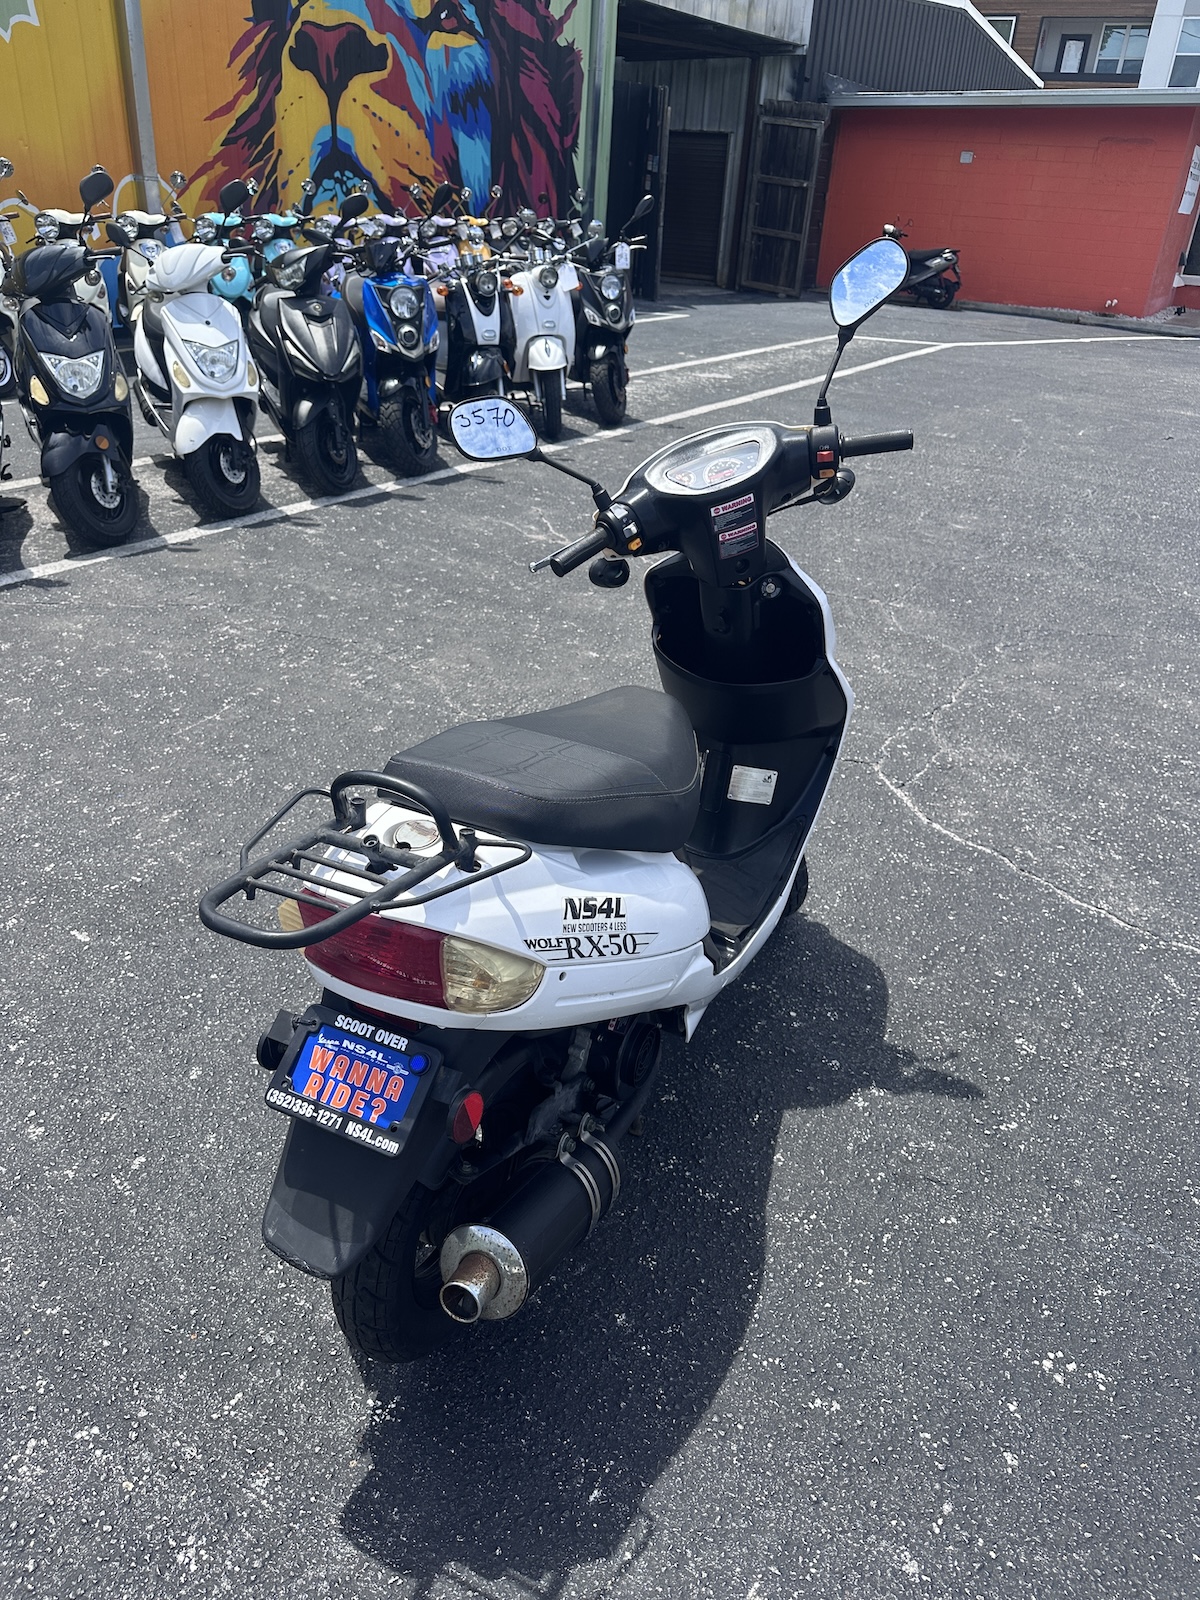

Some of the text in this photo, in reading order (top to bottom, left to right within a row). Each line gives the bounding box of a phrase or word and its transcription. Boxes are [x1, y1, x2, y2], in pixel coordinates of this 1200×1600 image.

[455, 407, 516, 428] 3570
[721, 497, 752, 511] WARNING
[563, 897, 626, 920] NS4L
[562, 924, 577, 933] NEW
[578, 922, 608, 932] SCOOTERS
[614, 922, 627, 931] LESS
[524, 934, 637, 959] WOLF RX-50
[334, 1014, 409, 1051] SCOOT OVER
[341, 1039, 389, 1063] NS4L
[308, 1045, 405, 1103] WANNA
[302, 1073, 387, 1124] RIDE?
[266, 1088, 400, 1155] (352)336-1271 NS4L.com
